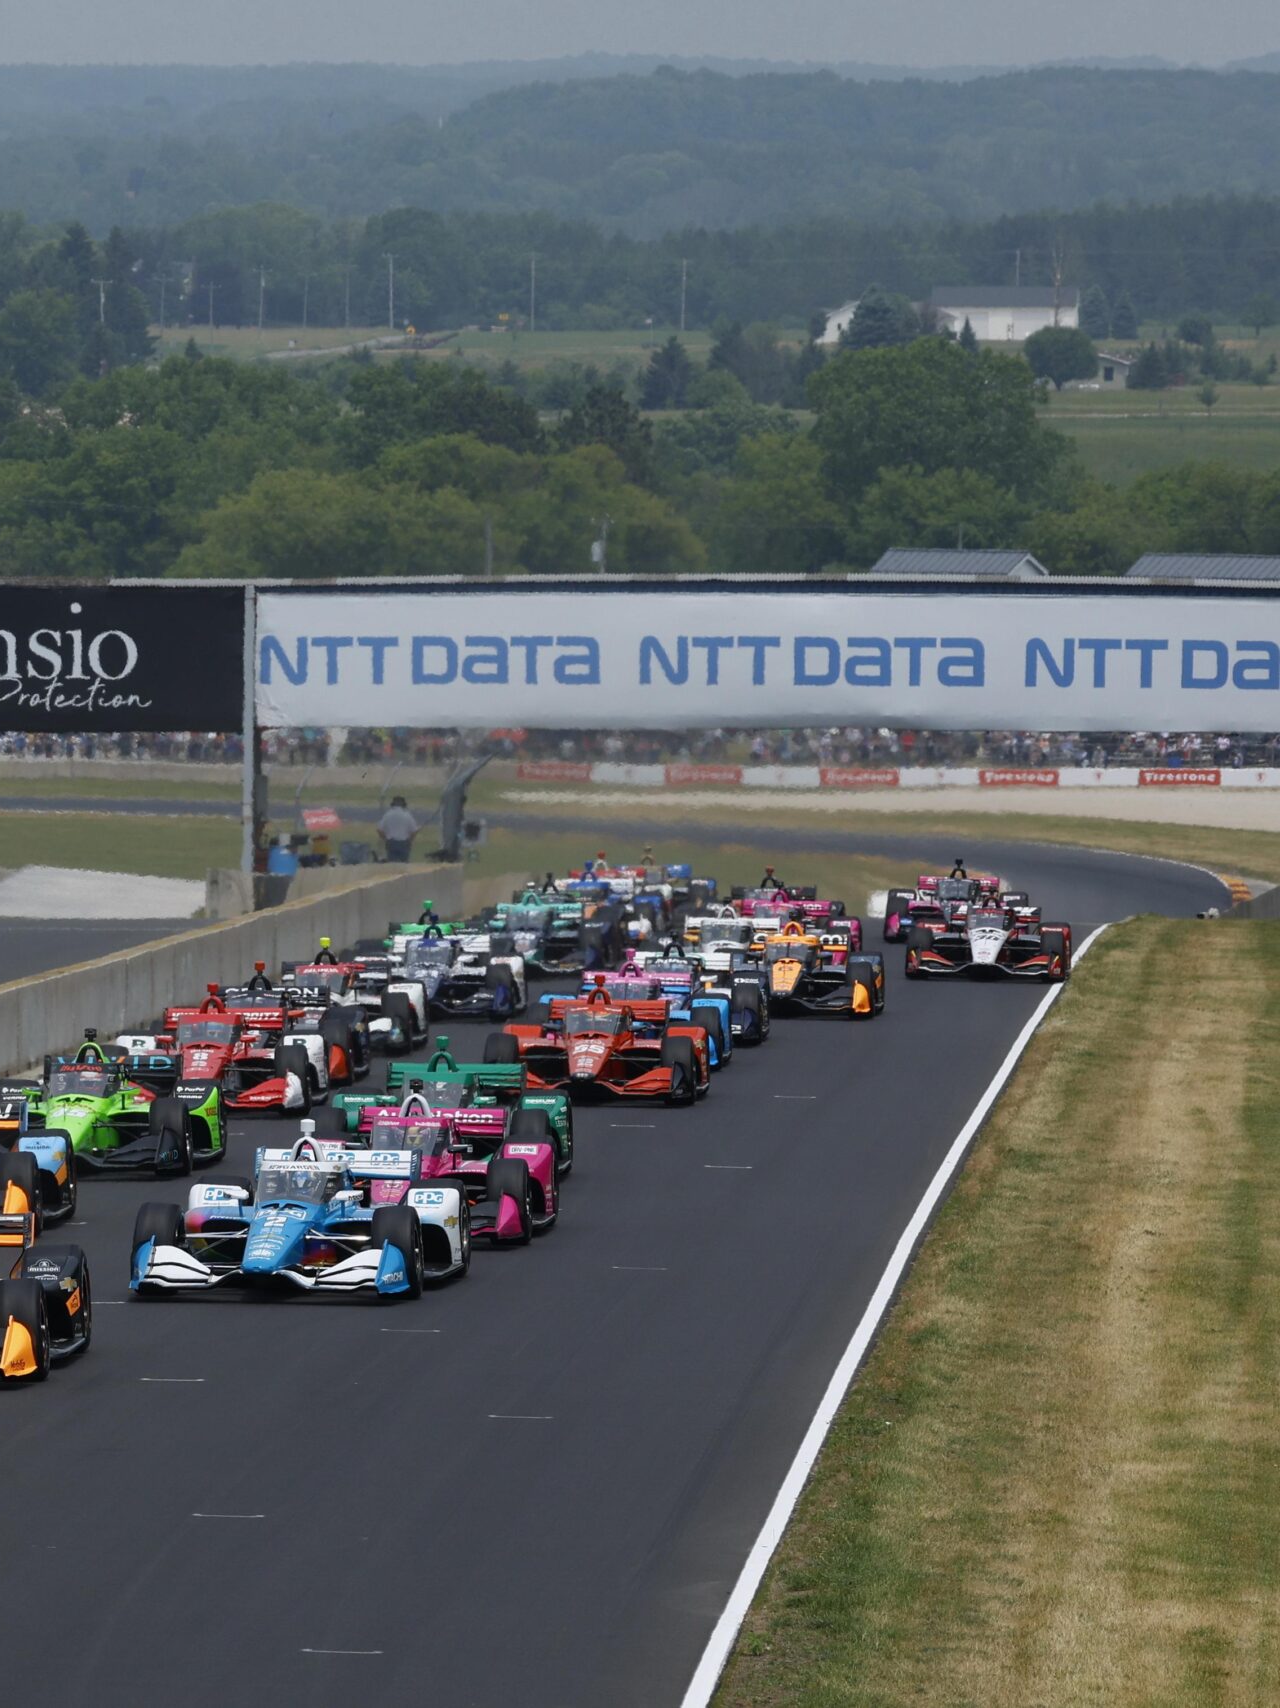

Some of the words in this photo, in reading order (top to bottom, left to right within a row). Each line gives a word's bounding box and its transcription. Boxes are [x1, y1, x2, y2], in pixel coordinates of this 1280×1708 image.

[260, 635, 400, 685] NTT
[639, 635, 781, 685] NTT
[1024, 637, 1169, 689] NTT
[1144, 772, 1216, 783] Firestone
[371, 1153, 400, 1165] PPG
[414, 1191, 444, 1204] PPG
[263, 1216, 287, 1227] 2
[381, 1271, 404, 1284] HITACHI
